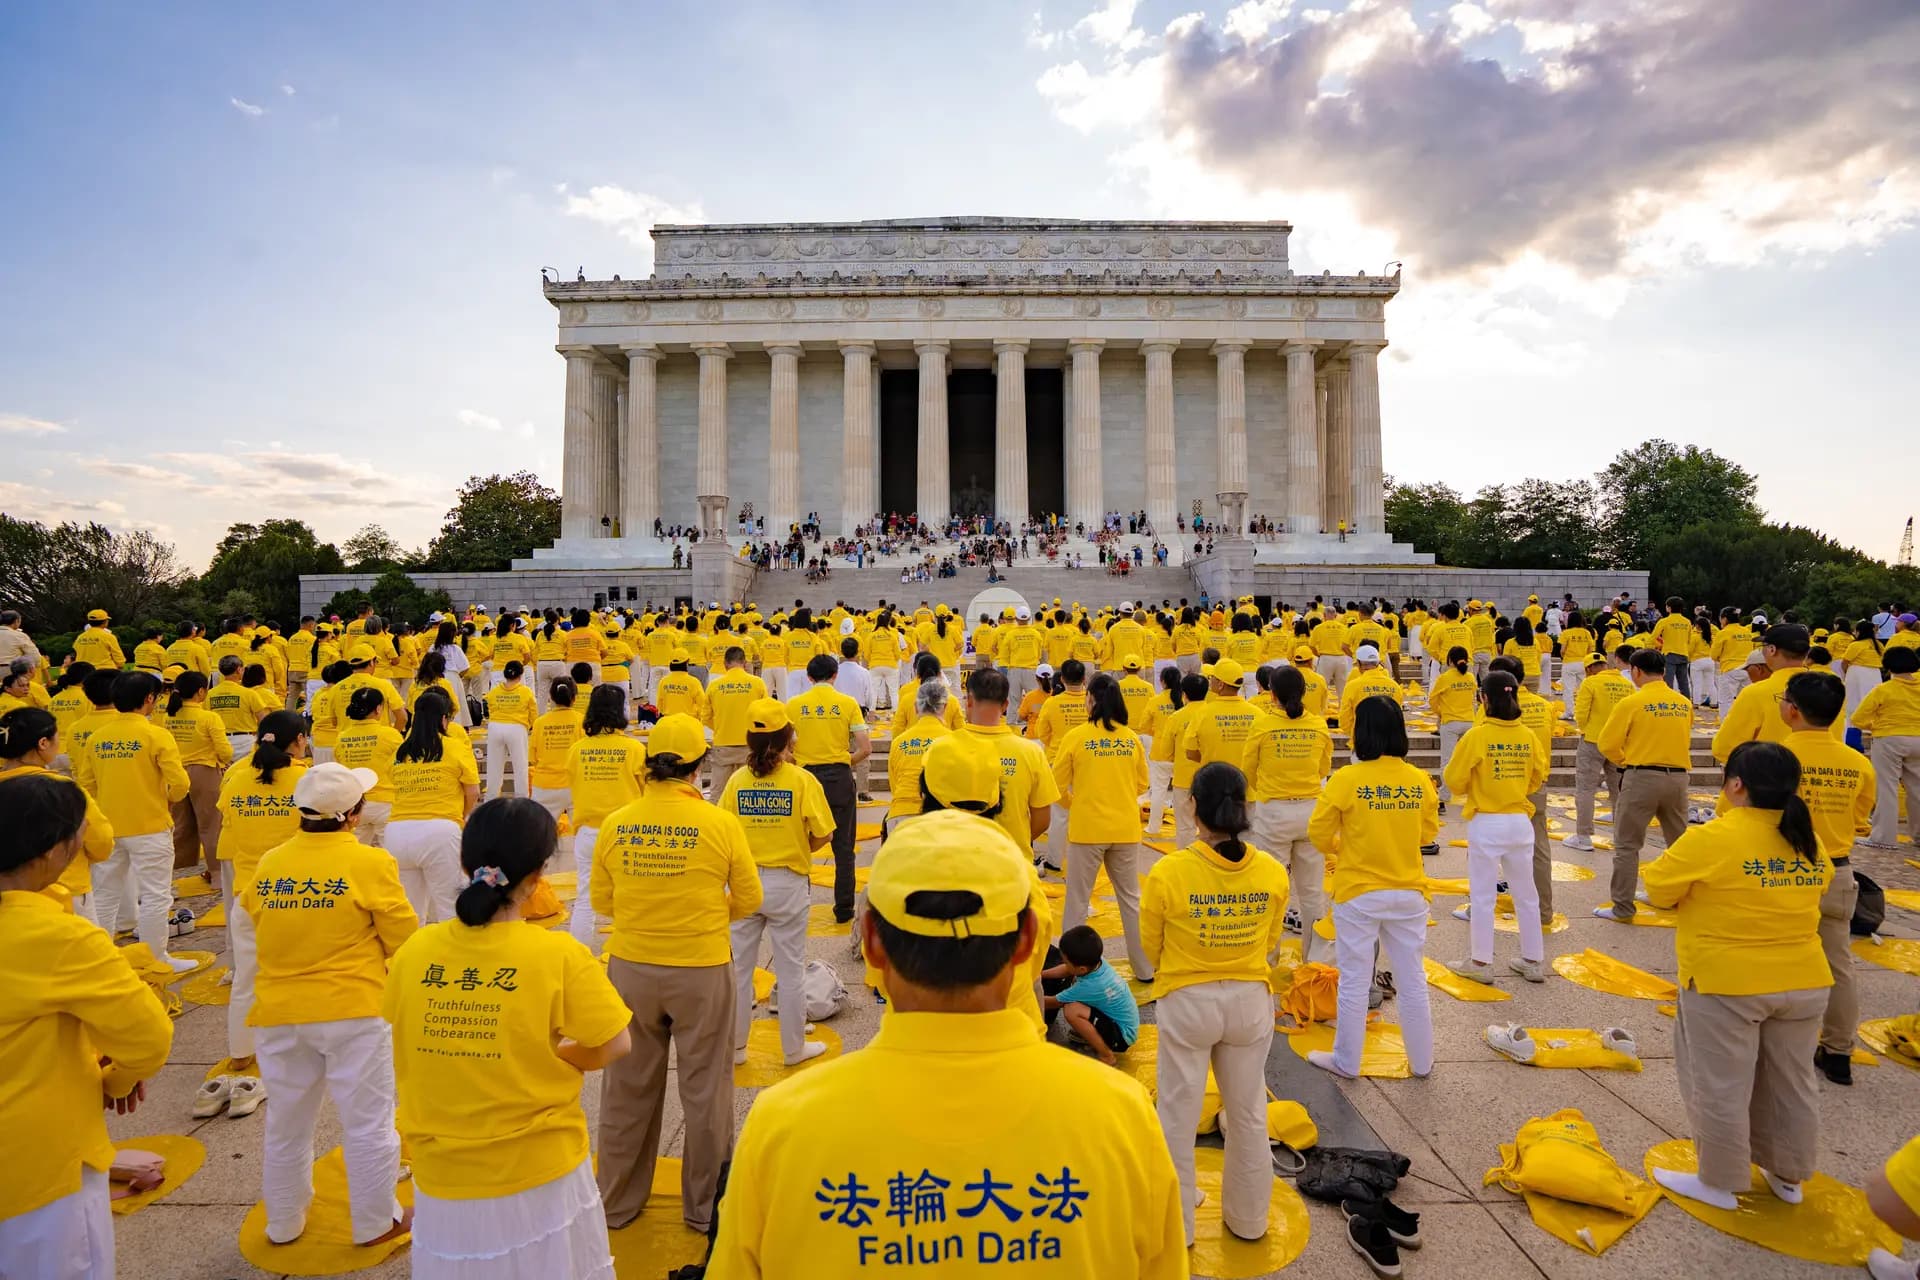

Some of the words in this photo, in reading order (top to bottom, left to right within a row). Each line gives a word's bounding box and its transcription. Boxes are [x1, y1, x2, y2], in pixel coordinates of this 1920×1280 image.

[1085, 738, 1136, 750] 法輪大法
[1357, 785, 1423, 800] 法輪大法
[230, 794, 297, 808] 法輪大法
[739, 797, 766, 808] FALUN
[767, 797, 791, 809] GONG
[1369, 801, 1396, 810] Falun
[1398, 800, 1420, 810] Dafa
[238, 809, 265, 817] Falun
[268, 808, 290, 816] Dafa
[642, 825, 662, 835] DAFA
[664, 826, 672, 836] IS
[674, 827, 699, 837] GOOD
[256, 877, 350, 896] 法輪大法
[1761, 877, 1791, 888] Falun
[1795, 875, 1823, 886] Dafa
[262, 898, 299, 909] Falun
[302, 897, 334, 909] Dafa
[1189, 894, 1216, 905] FALUN
[1217, 894, 1237, 905] DAFA
[1238, 893, 1247, 904] IS
[1248, 892, 1270, 903] GOOD
[1189, 904, 1267, 919] 法輪大法好
[427, 998, 502, 1013] Truthfulness
[424, 1012, 498, 1027] Compassion
[423, 1026, 497, 1040] Forbearance
[815, 1166, 1090, 1228] 法輪大法
[858, 1233, 964, 1267] Falun
[978, 1229, 1062, 1264] Dafa
